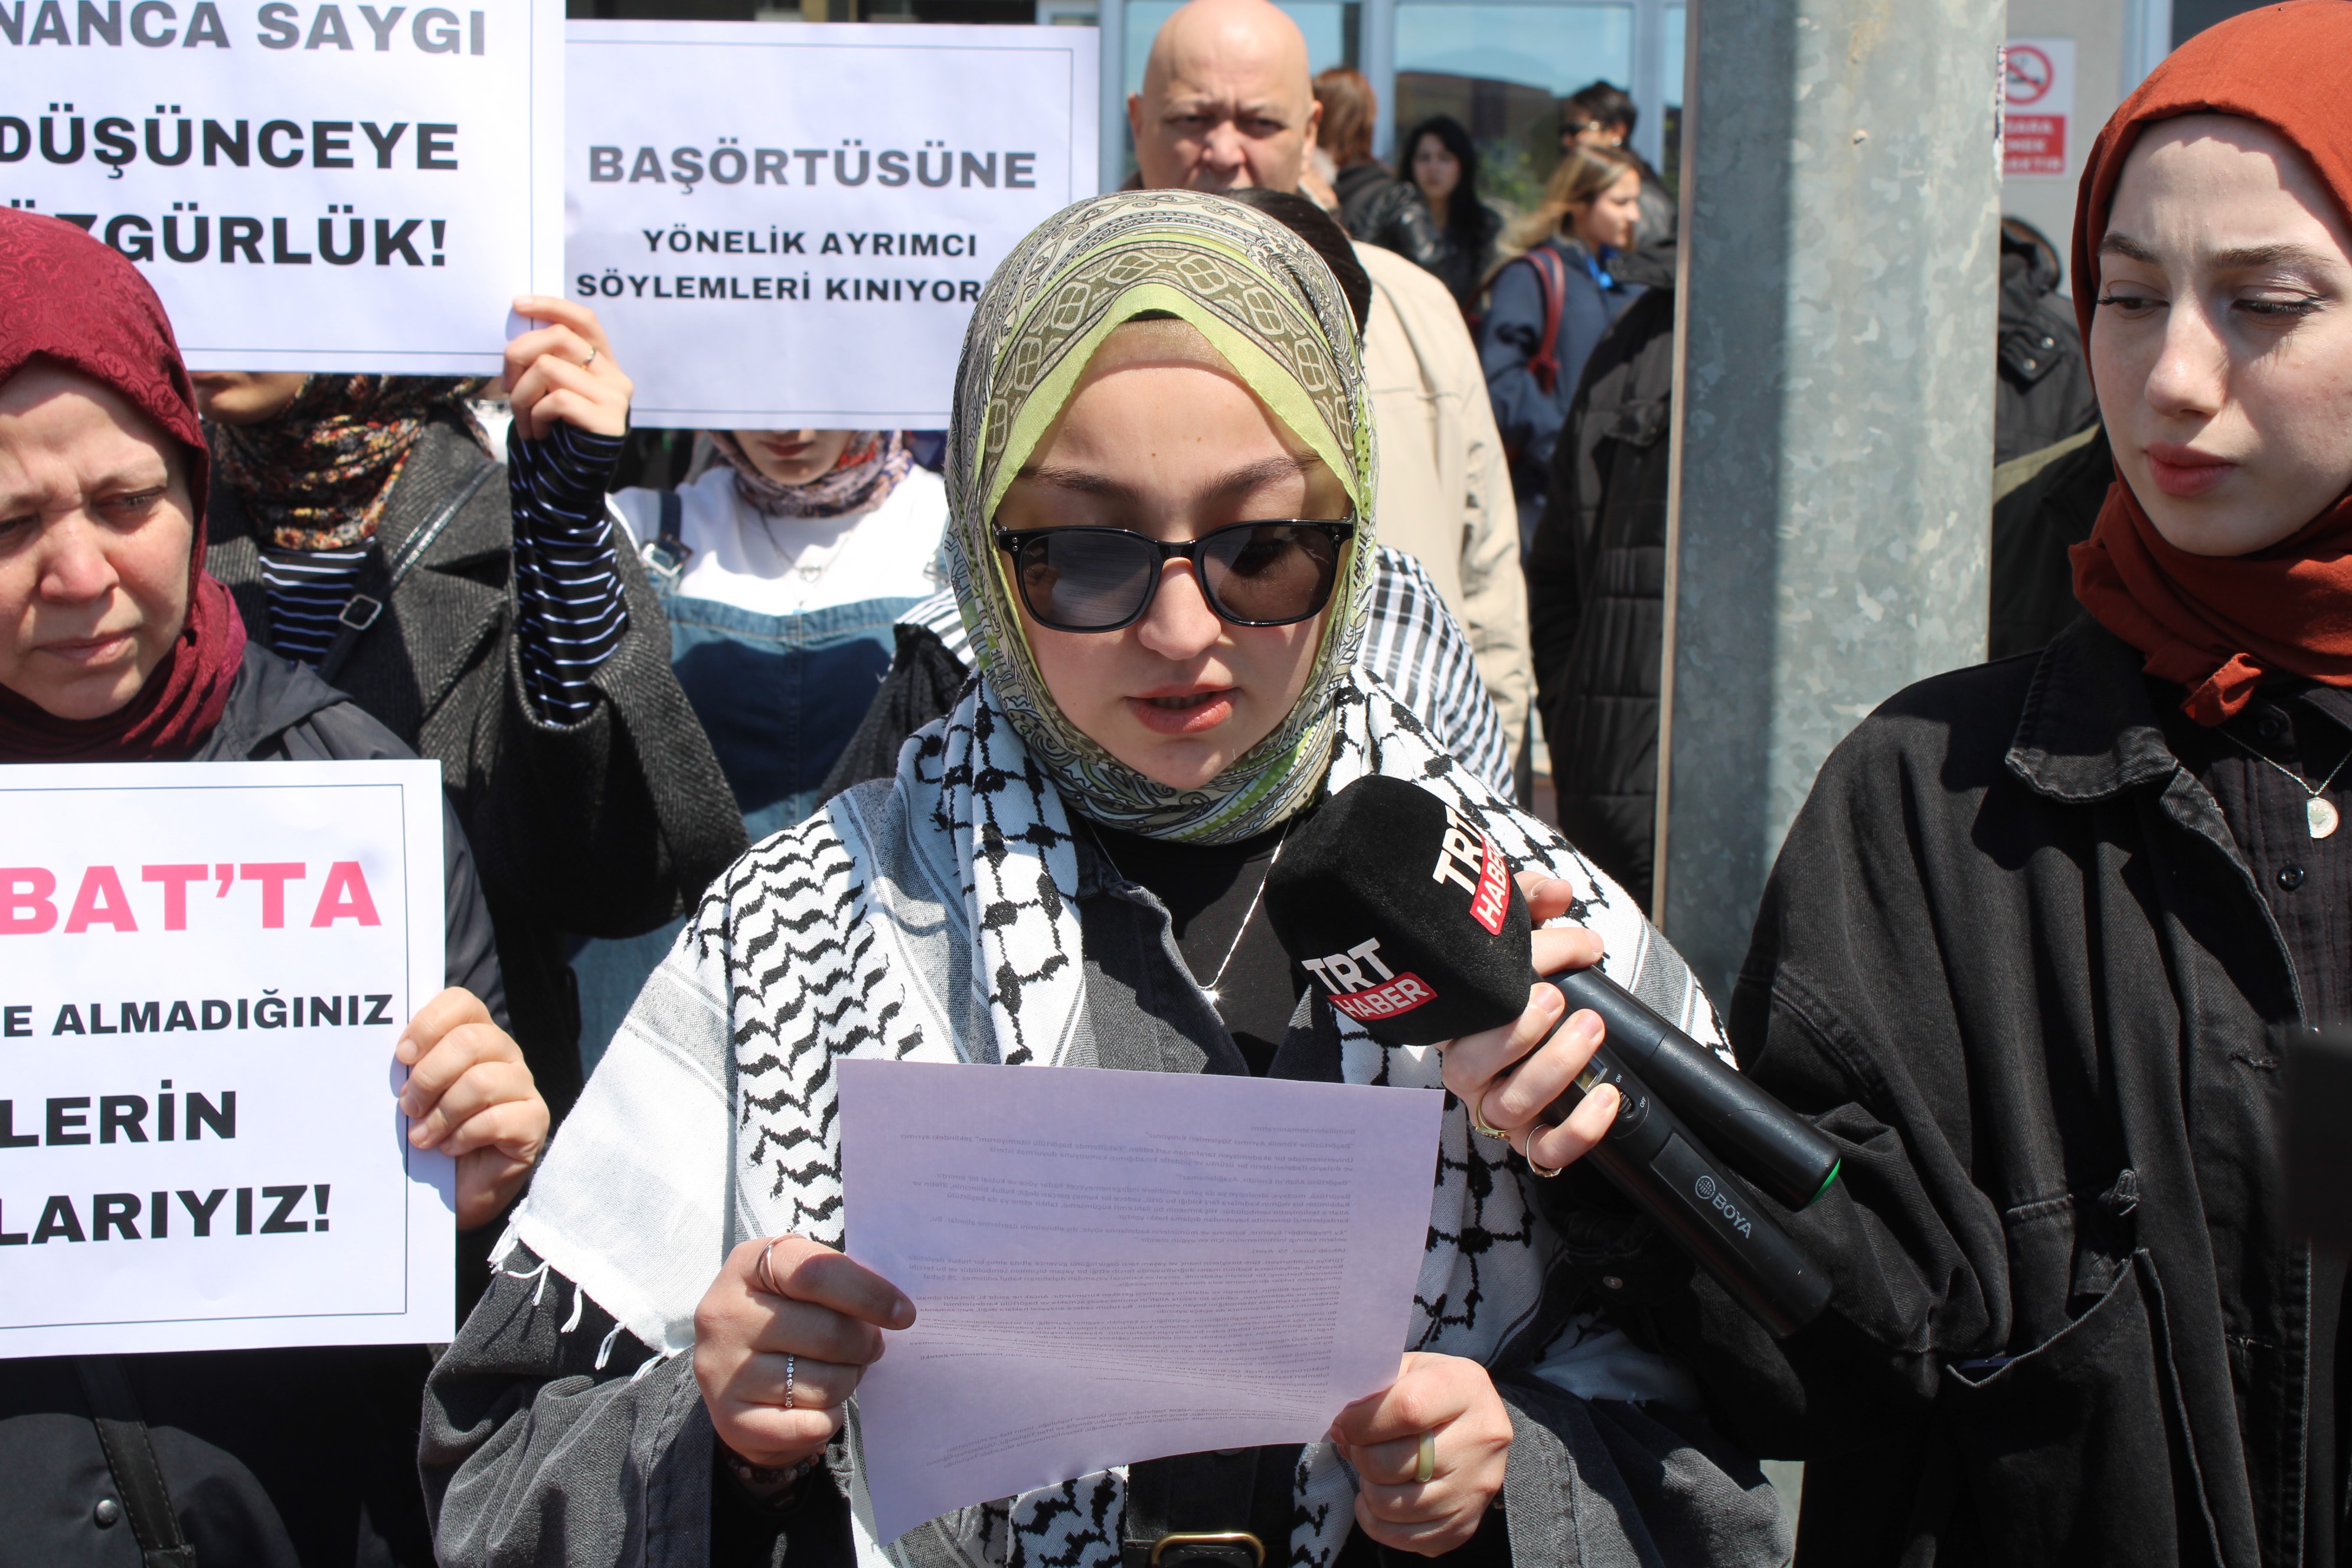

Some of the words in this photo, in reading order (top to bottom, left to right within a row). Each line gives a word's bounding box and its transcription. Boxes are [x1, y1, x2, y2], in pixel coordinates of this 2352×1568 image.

[257, 3, 485, 55] SAYGI
[0, 103, 458, 179] DÜŞÜNCEYE
[589, 138, 1037, 194] BAŞÖRTÜSÜNE
[11, 200, 446, 267] GÜRLÜK!
[643, 224, 806, 254] YÖNELİK
[821, 233, 976, 256] AYRIMCI
[577, 269, 810, 300] SÖYLEMLERİ
[826, 278, 985, 303] KINIYOR
[1433, 805, 1484, 896] TRT
[0, 861, 382, 936] BAT'TA
[1476, 842, 1508, 928] HABER
[1301, 937, 1394, 995] TRT
[4, 1005, 33, 1037] E
[52, 989, 393, 1036] ALMADIĞINIZ
[1335, 978, 1429, 1018] HABER
[1615, 1073, 1622, 1083] ON
[0, 1079, 236, 1148] LERİN
[1711, 1192, 1752, 1239] BOYA
